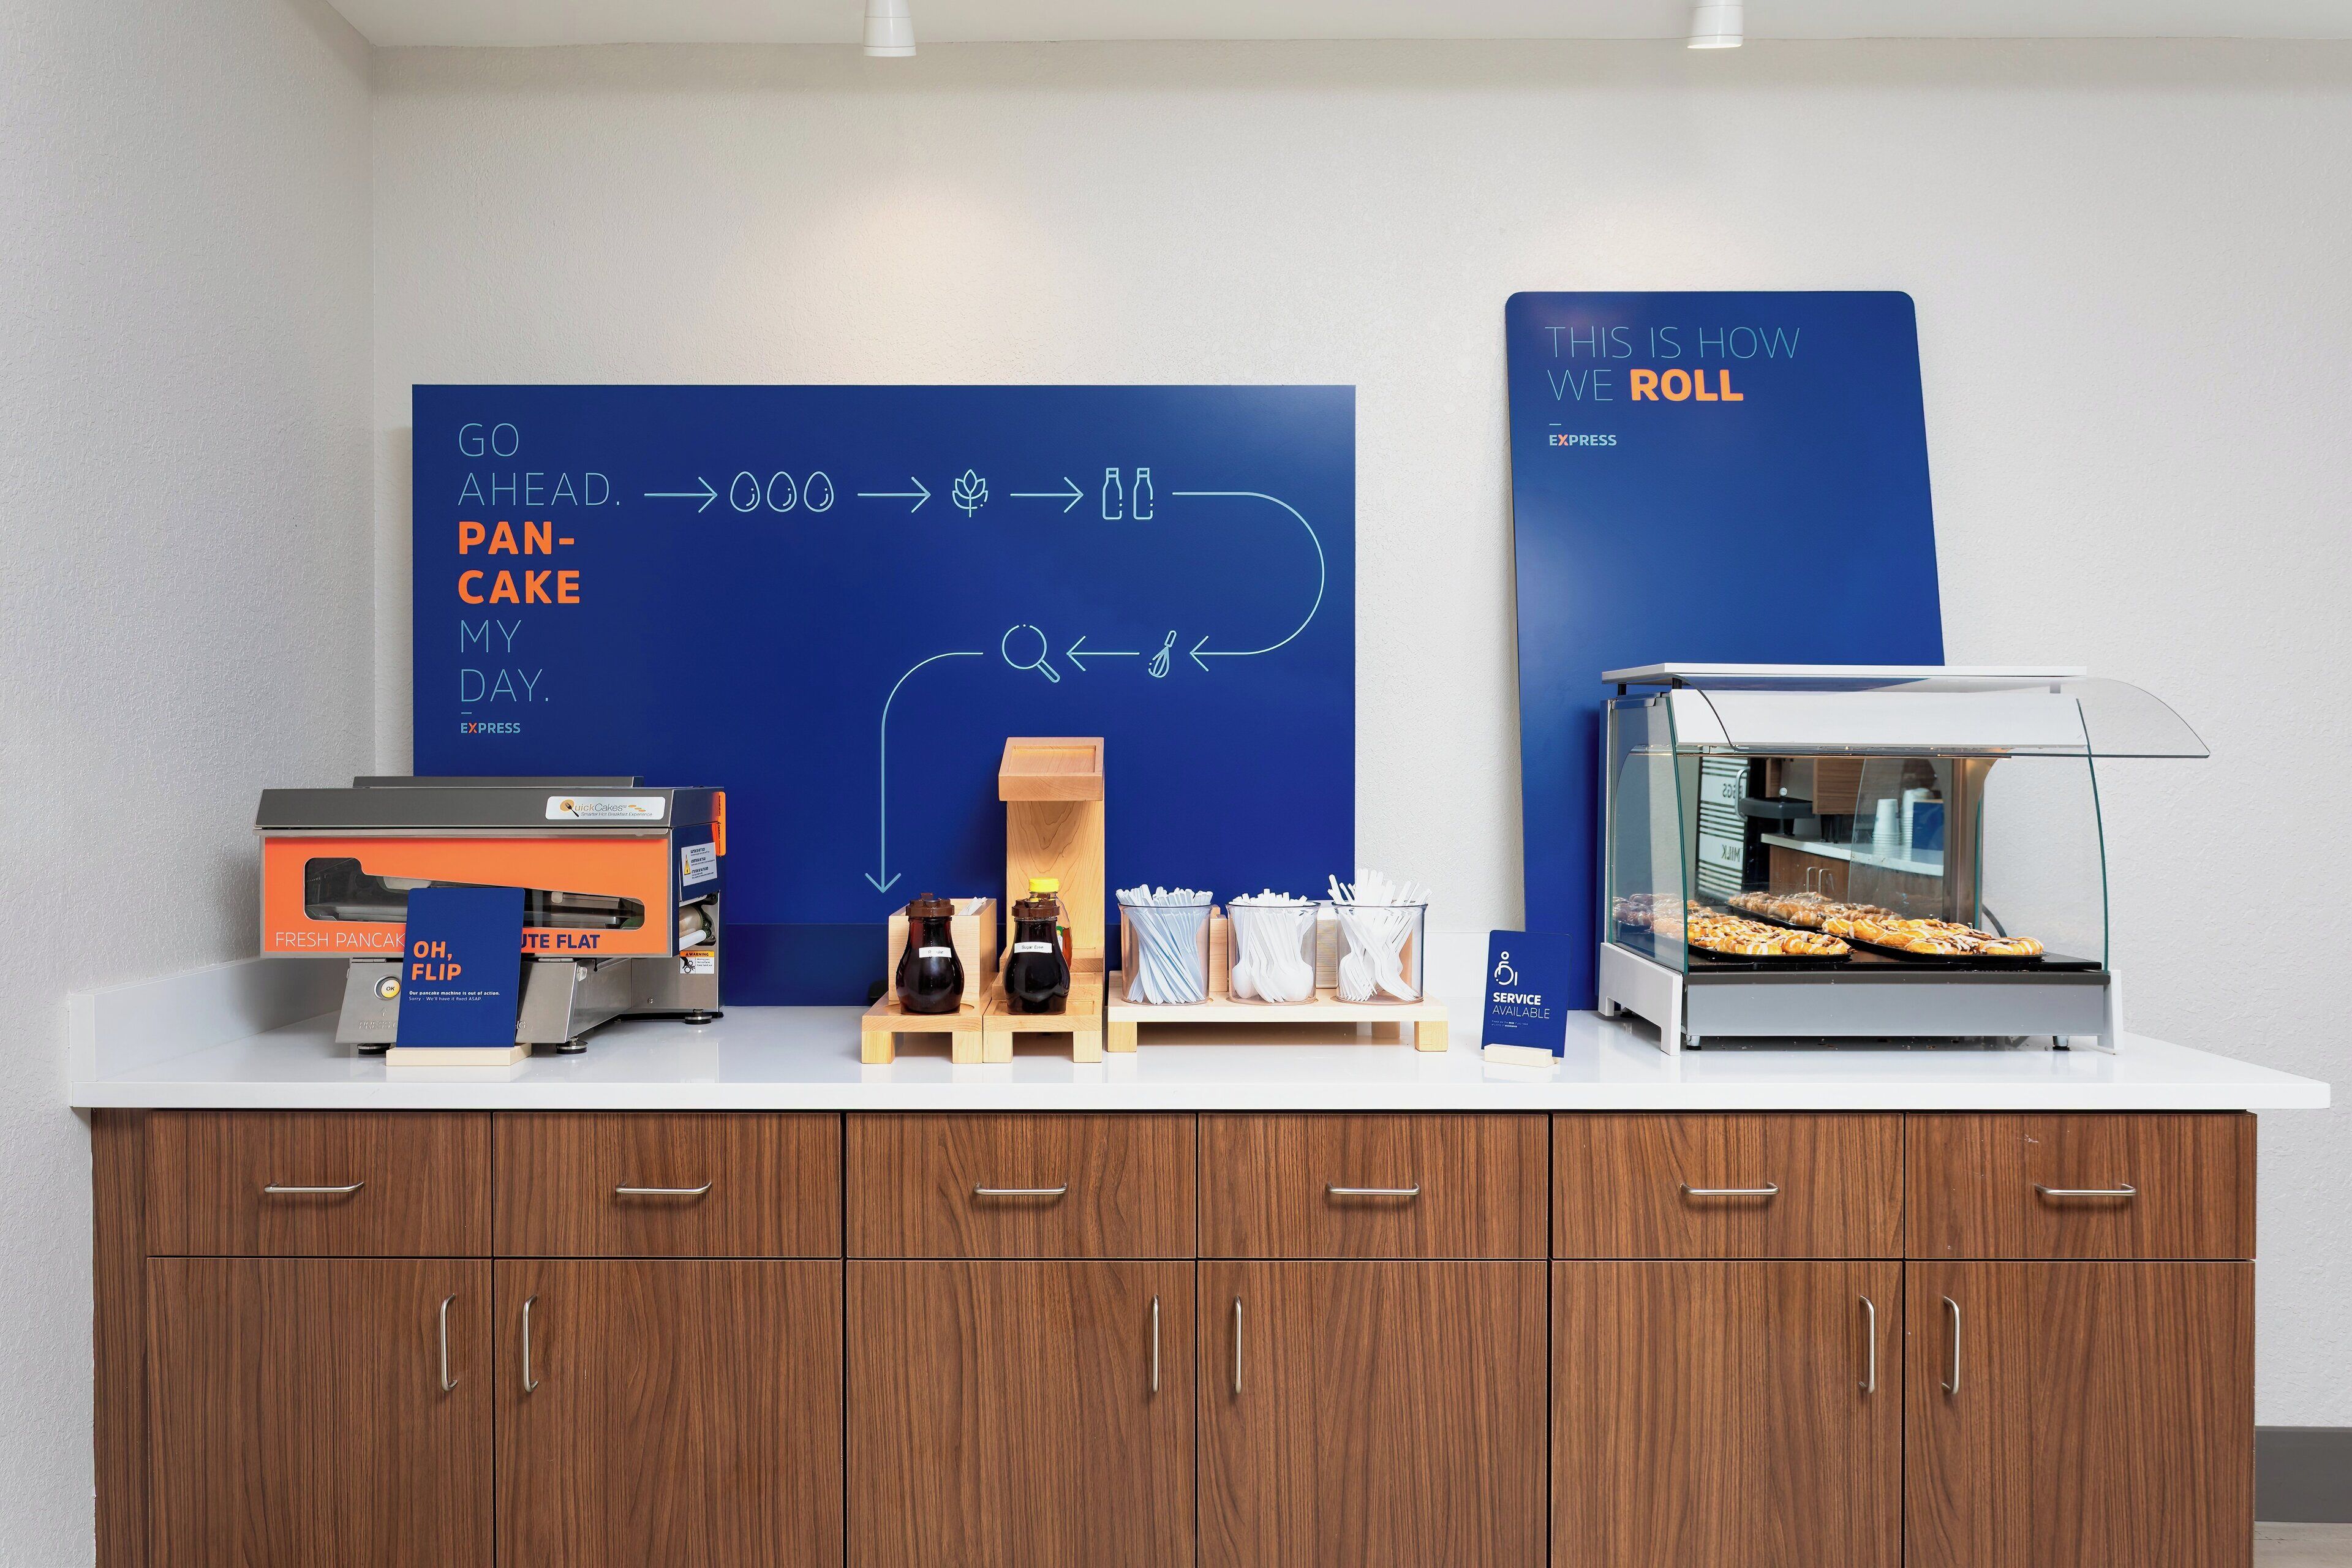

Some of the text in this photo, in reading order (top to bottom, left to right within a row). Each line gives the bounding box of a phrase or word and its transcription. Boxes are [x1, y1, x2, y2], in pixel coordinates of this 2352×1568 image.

[1545, 326, 1800, 358] THIS IS HOW
[1547, 369, 1744, 401] WE ROLL
[458, 423, 519, 457] GO
[1549, 434, 1617, 447] EXPRESS
[458, 472, 621, 505] AHEAD.
[459, 521, 575, 555] PAN-
[458, 570, 580, 604] CAKE
[461, 620, 521, 653] MY
[461, 669, 548, 702] DAY.
[461, 722, 521, 734] EXPRESS
[276, 932, 328, 947] FRESH
[557, 934, 600, 948] FLAT
[413, 941, 453, 960] OH,
[411, 963, 462, 981] FLIP
[1492, 1005, 1550, 1019] AVAILABLE
[1493, 992, 1542, 1006] SERVICE
